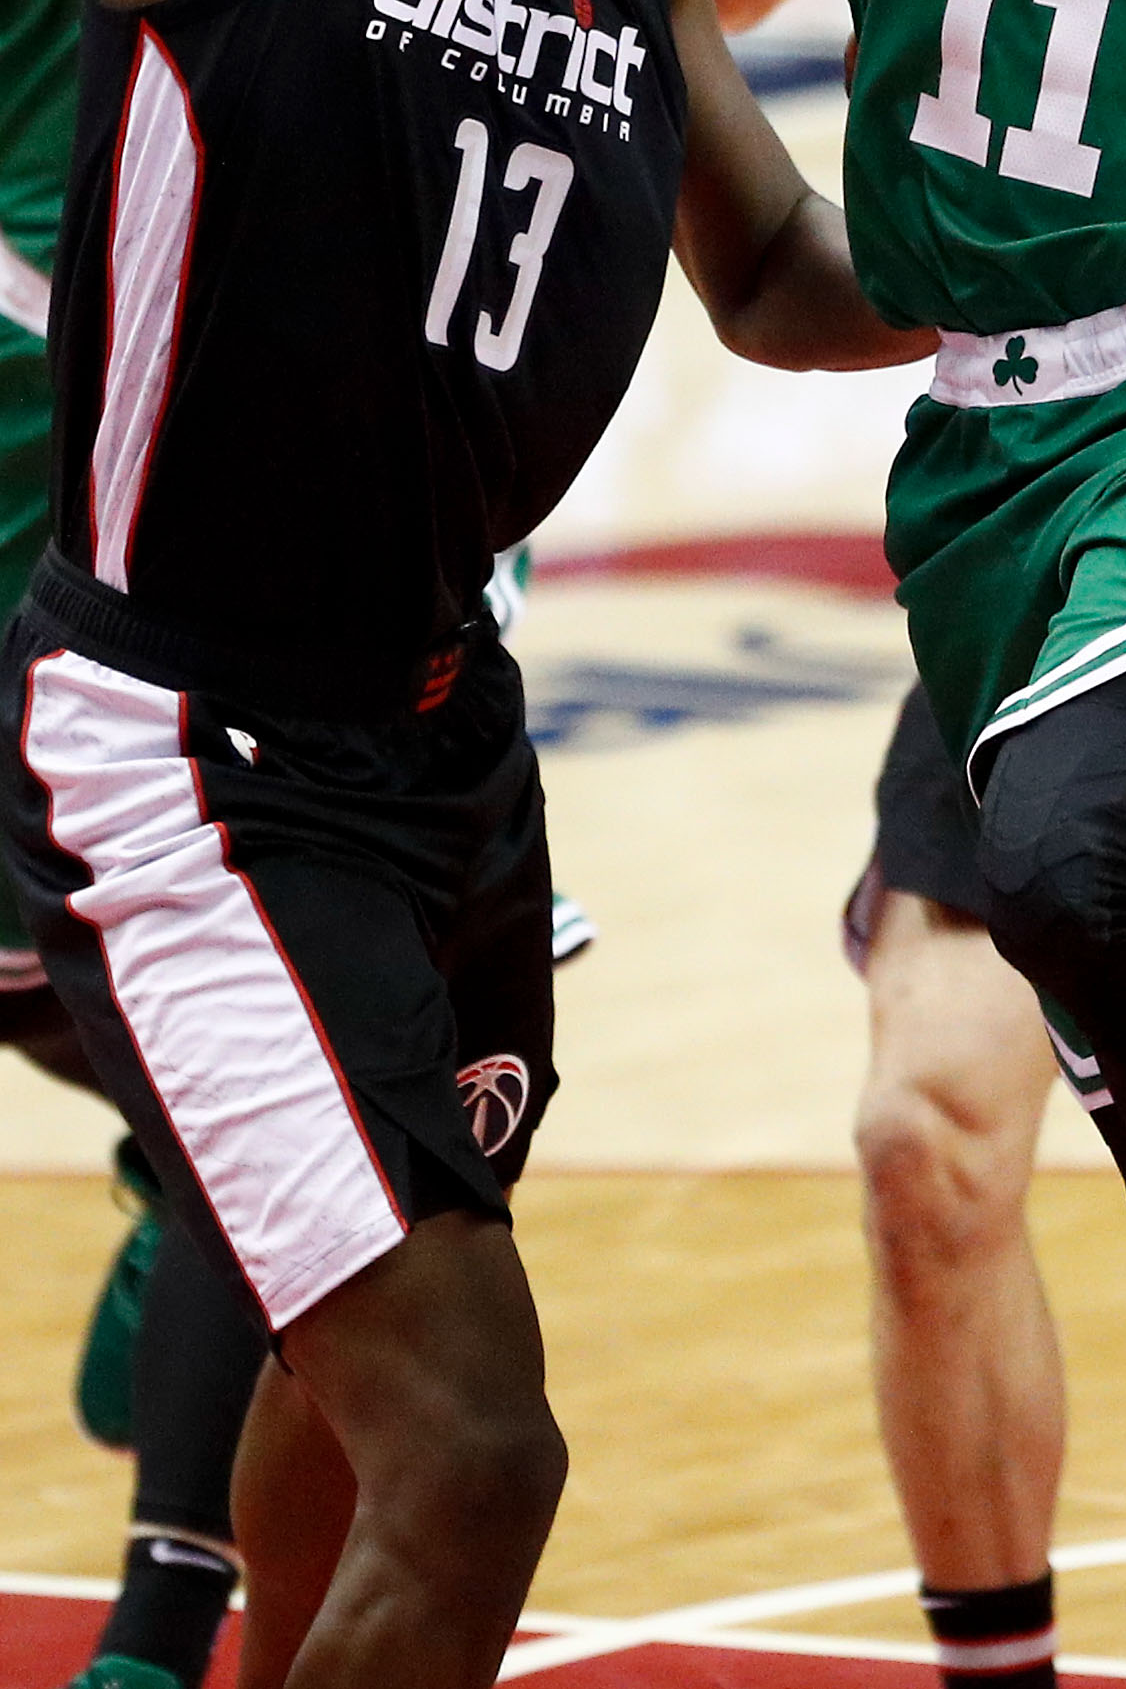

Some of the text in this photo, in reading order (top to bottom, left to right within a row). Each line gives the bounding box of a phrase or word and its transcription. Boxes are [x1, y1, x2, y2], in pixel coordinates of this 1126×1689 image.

[365, 19, 630, 142] OF COLUMBIA
[424, 117, 575, 372] 13
